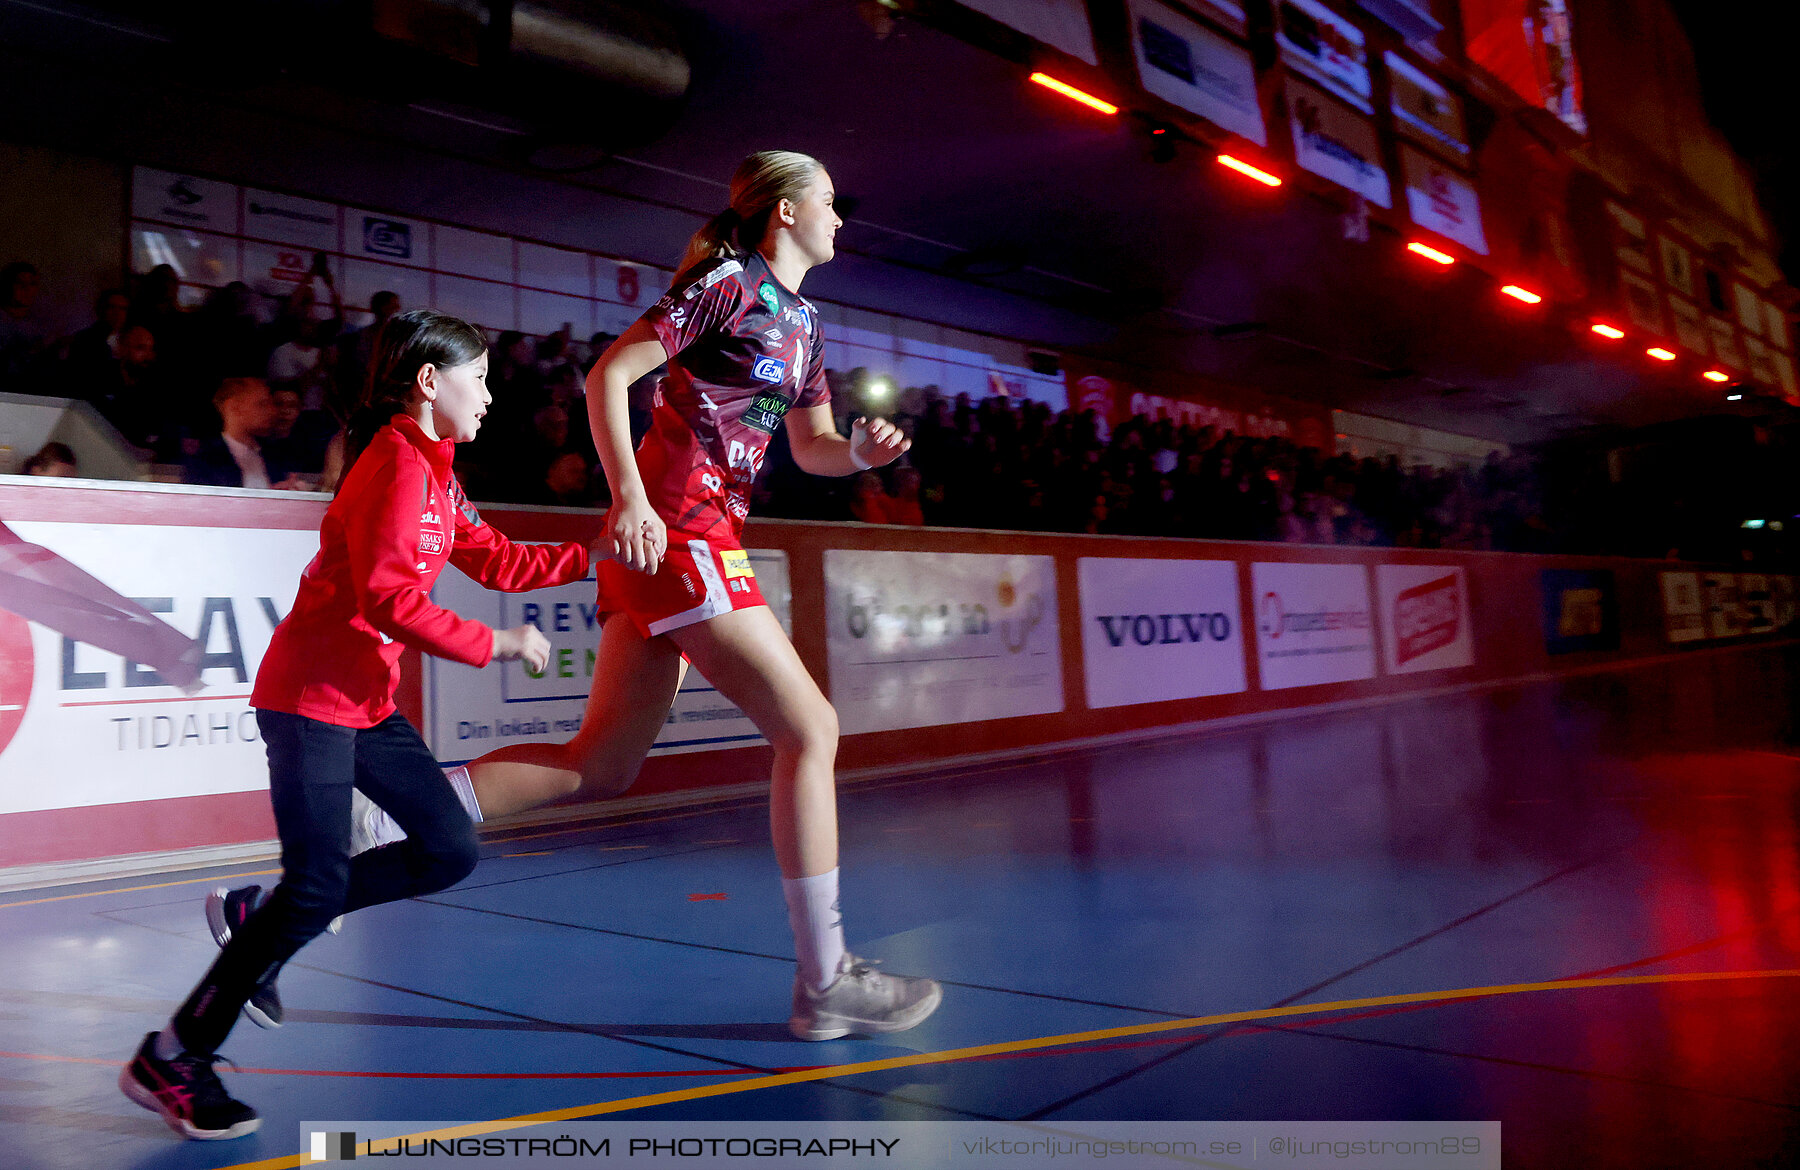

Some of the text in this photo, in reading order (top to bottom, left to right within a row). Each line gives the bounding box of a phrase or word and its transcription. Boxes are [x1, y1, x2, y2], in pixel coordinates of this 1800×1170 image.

[754, 358, 784, 383] CEJN
[1097, 612, 1230, 647] VOLVO
[457, 721, 491, 740] Din
[495, 717, 550, 737] lokala
